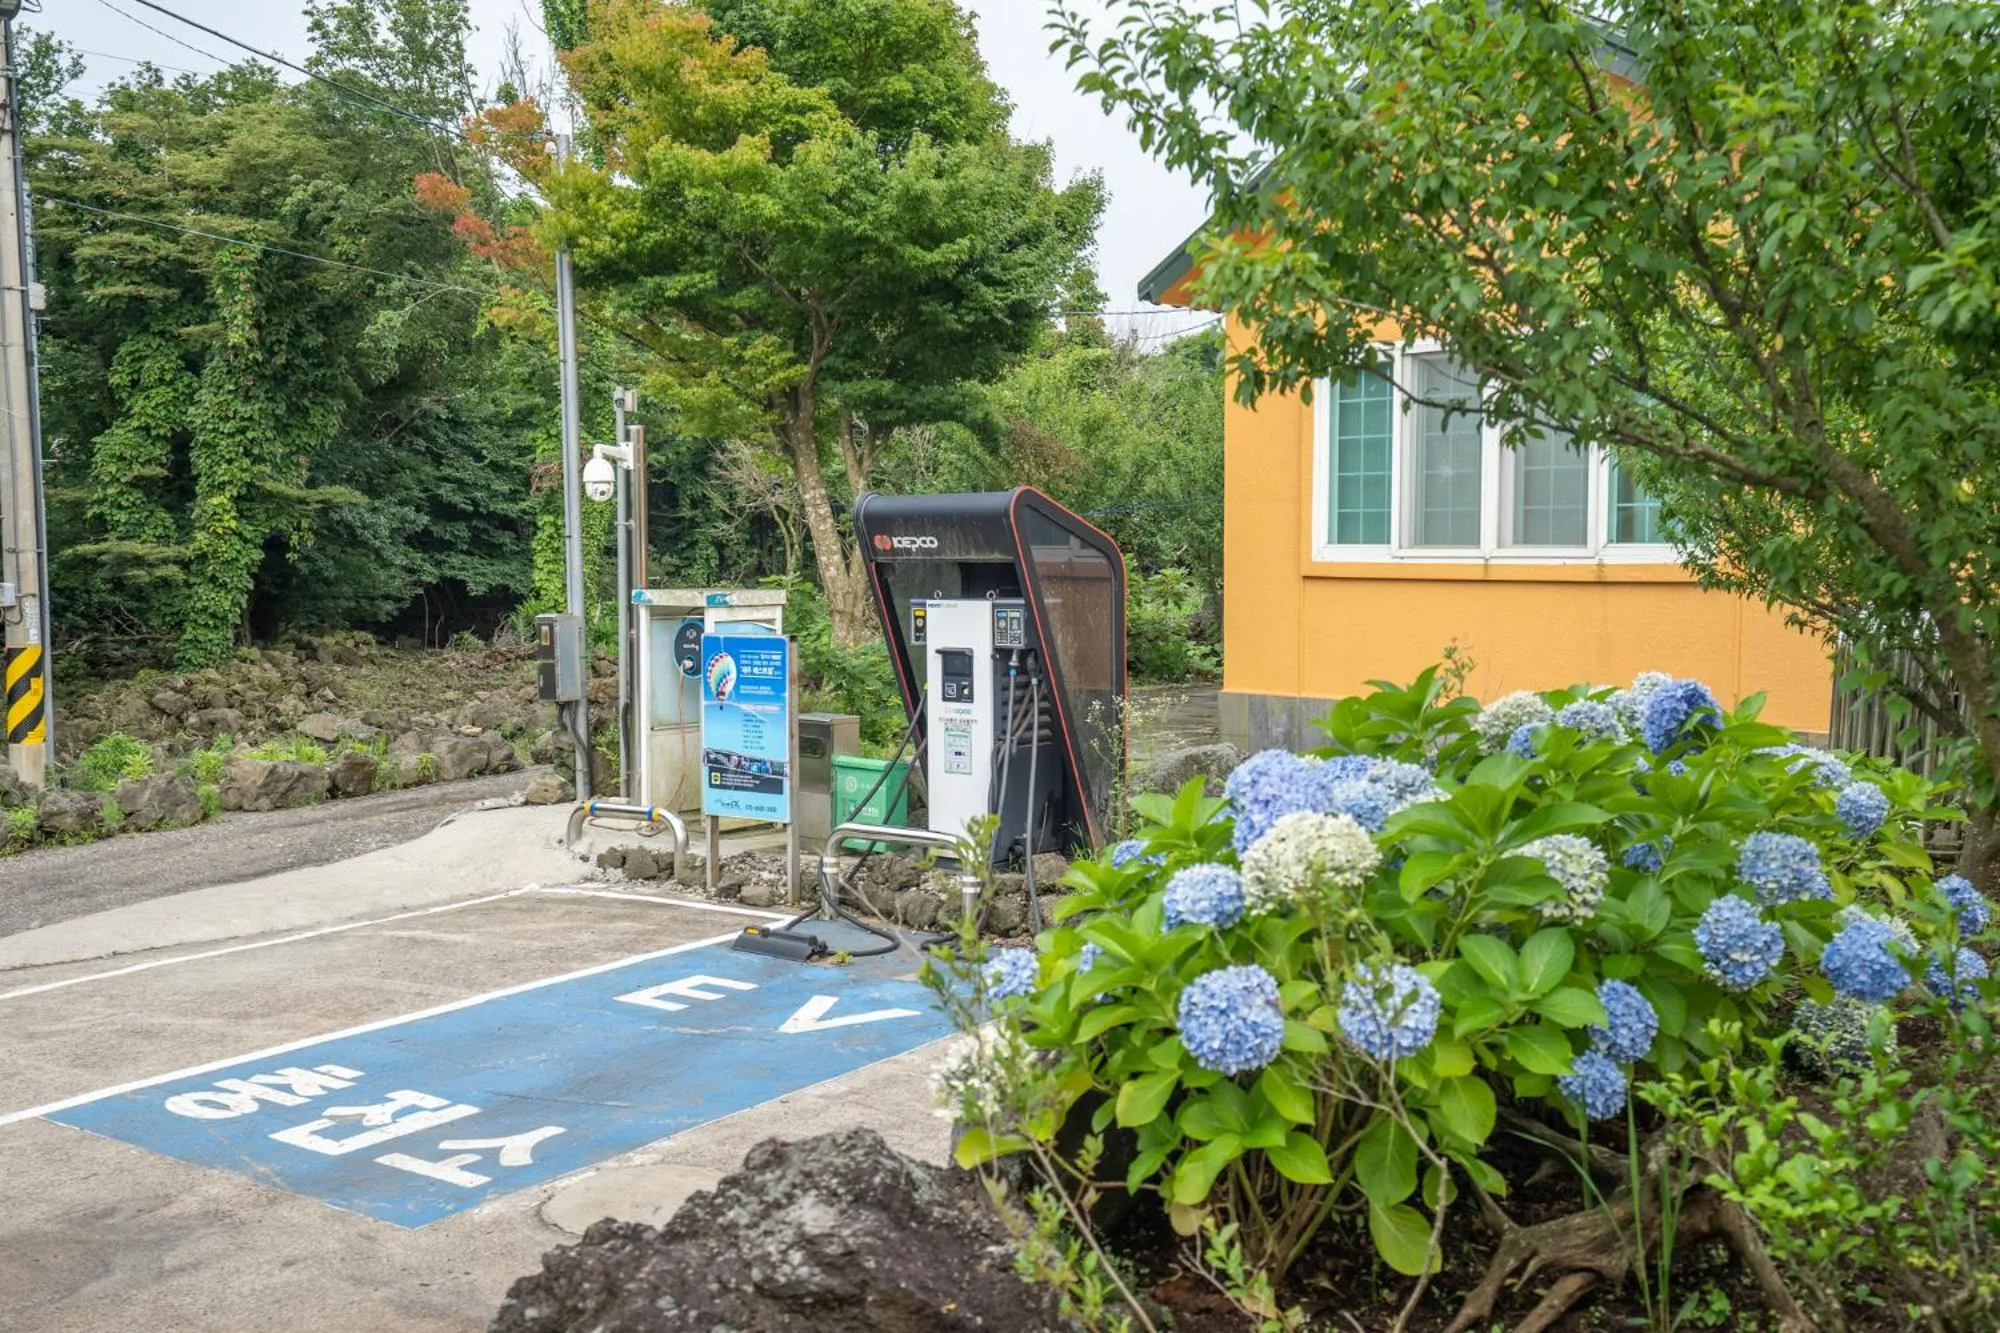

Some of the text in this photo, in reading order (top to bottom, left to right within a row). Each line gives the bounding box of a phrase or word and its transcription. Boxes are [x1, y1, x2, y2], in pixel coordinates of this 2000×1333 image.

[892, 536, 938, 552] KEPCO
[613, 974, 922, 1034] EV
[164, 1064, 568, 1189] 충전소
